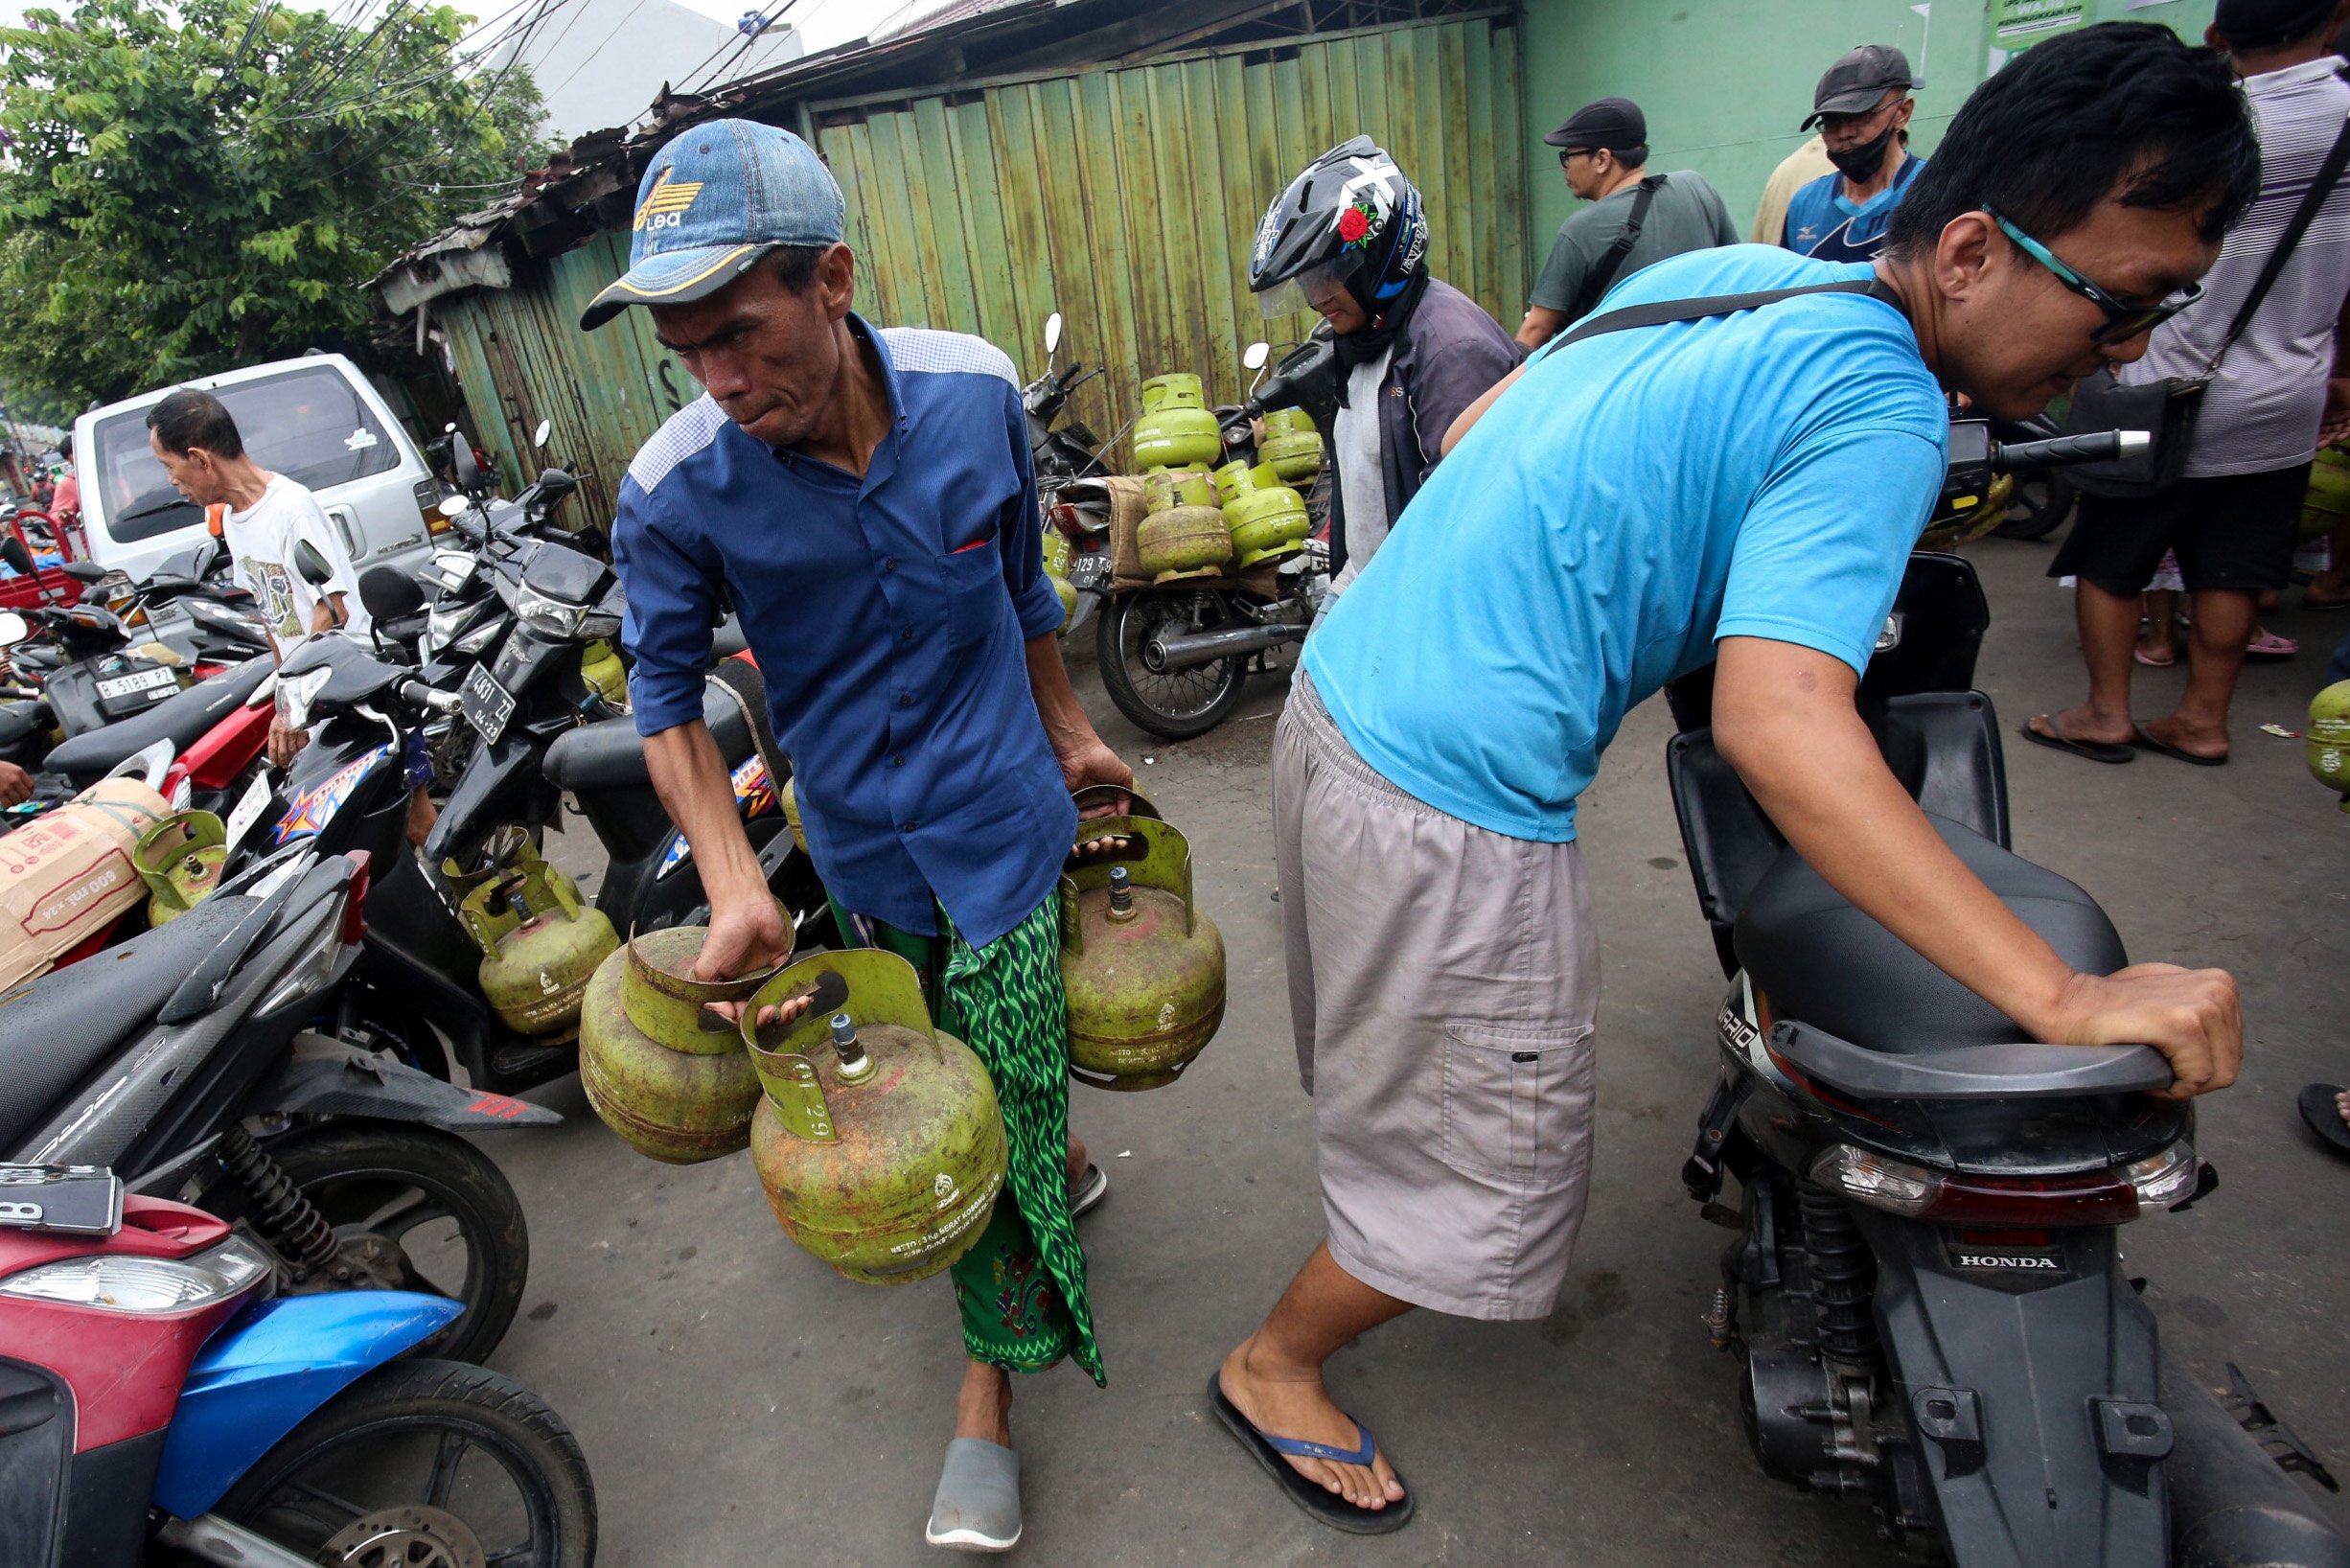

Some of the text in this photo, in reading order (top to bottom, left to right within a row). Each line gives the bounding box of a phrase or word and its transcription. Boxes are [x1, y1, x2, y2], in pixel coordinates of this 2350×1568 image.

[101, 669, 172, 697] B 5189 PZ
[473, 675, 495, 704] 4831
[89, 869, 117, 893] 600
[889, 1240, 917, 1254] NETO
[1960, 1256, 2058, 1269] HONDA
